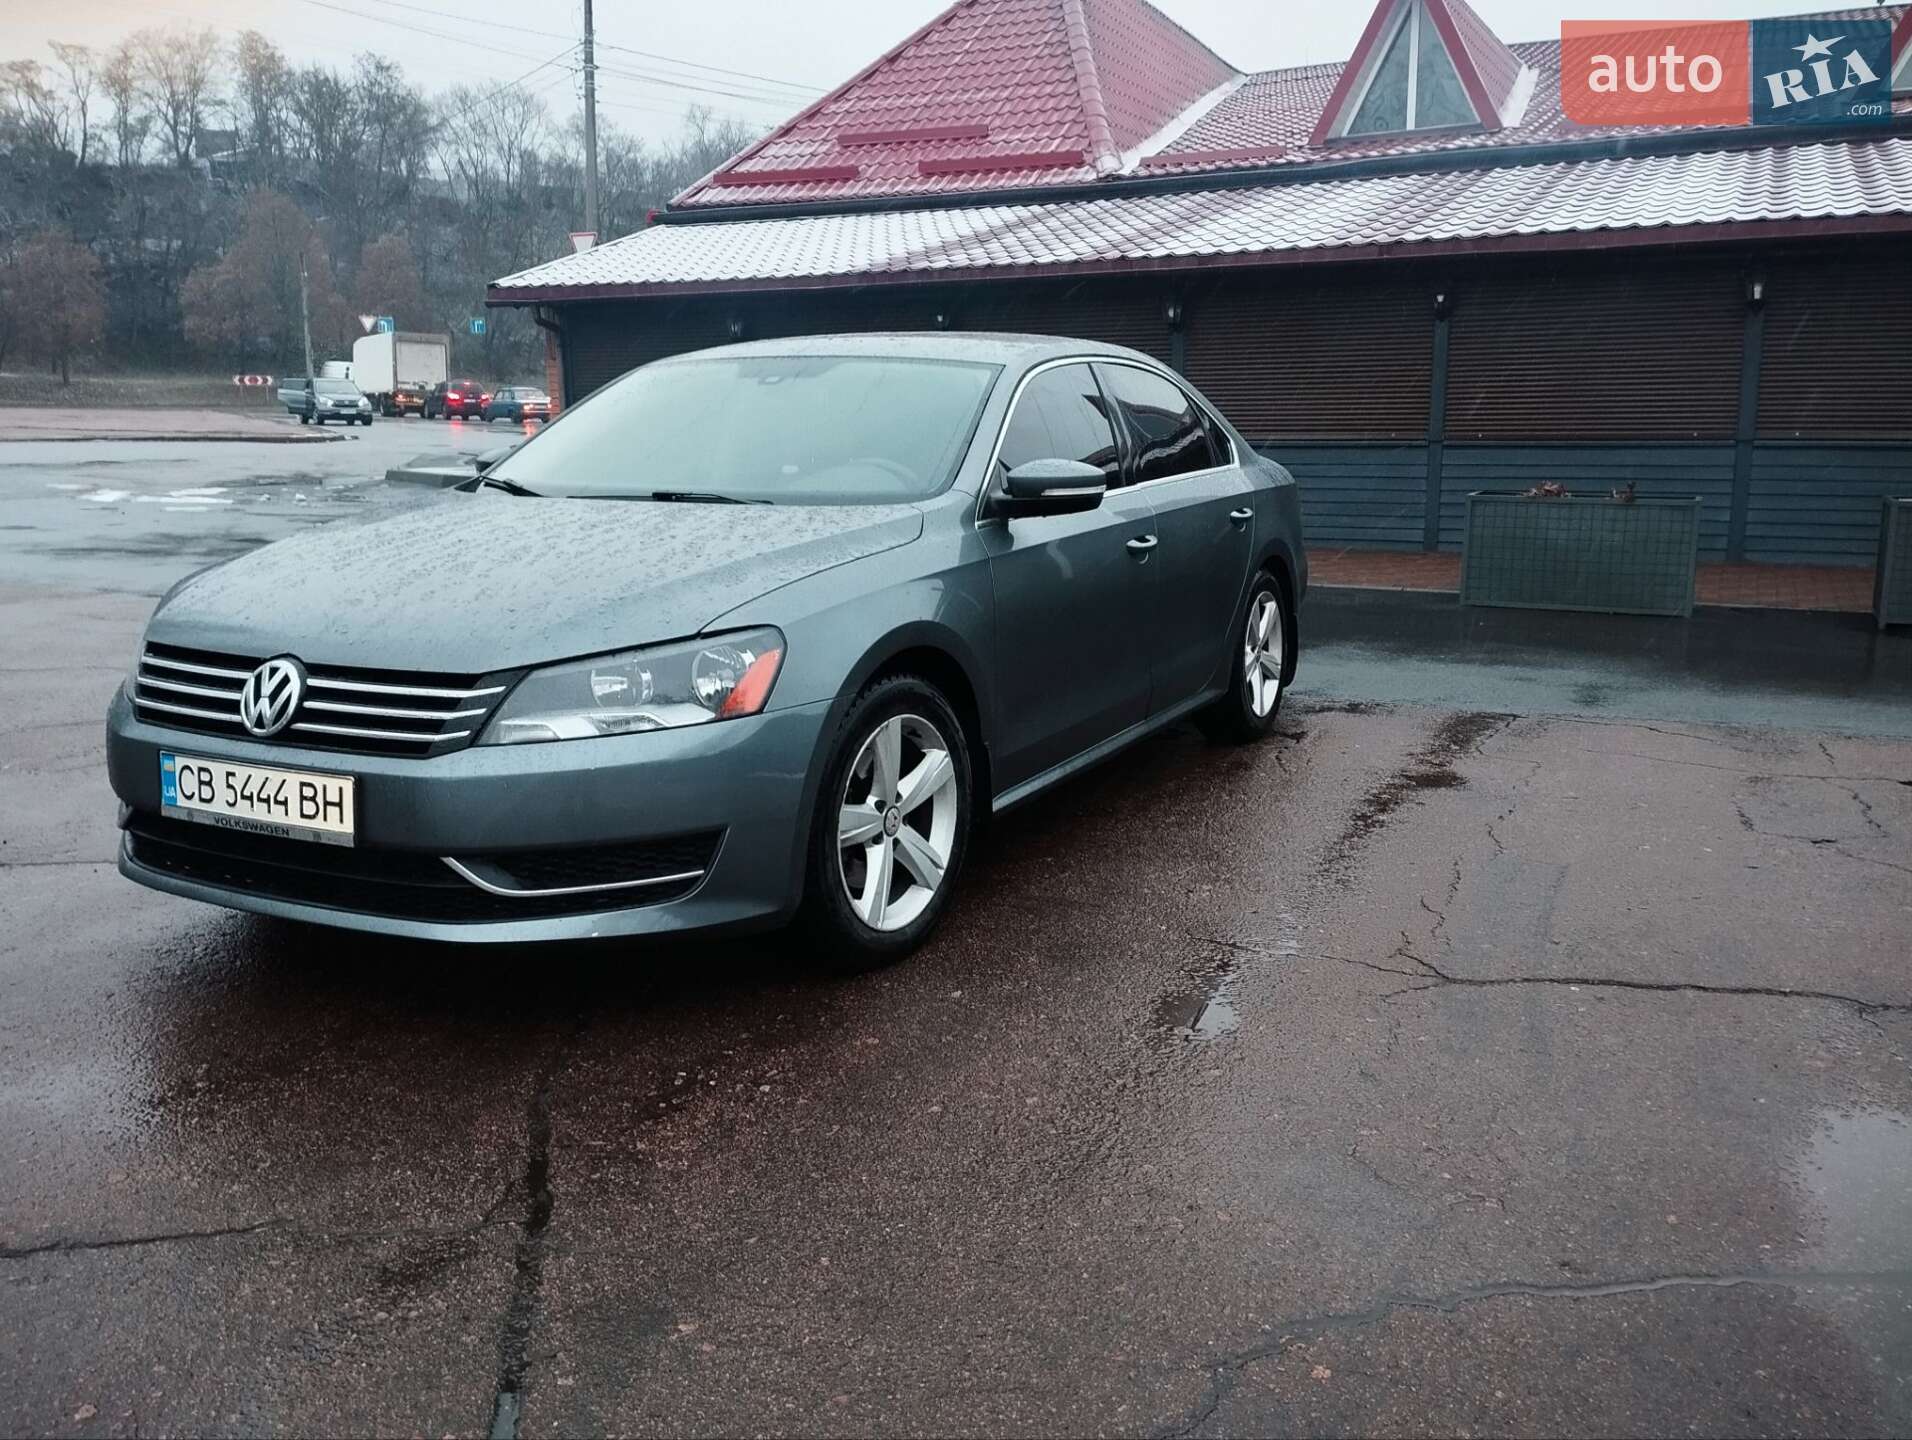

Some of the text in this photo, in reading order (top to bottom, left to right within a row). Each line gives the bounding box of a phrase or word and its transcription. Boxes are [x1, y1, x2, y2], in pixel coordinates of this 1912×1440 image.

[179, 765, 344, 824] CB 5444 BH
[214, 817, 290, 837] VOLKSWAGEN
